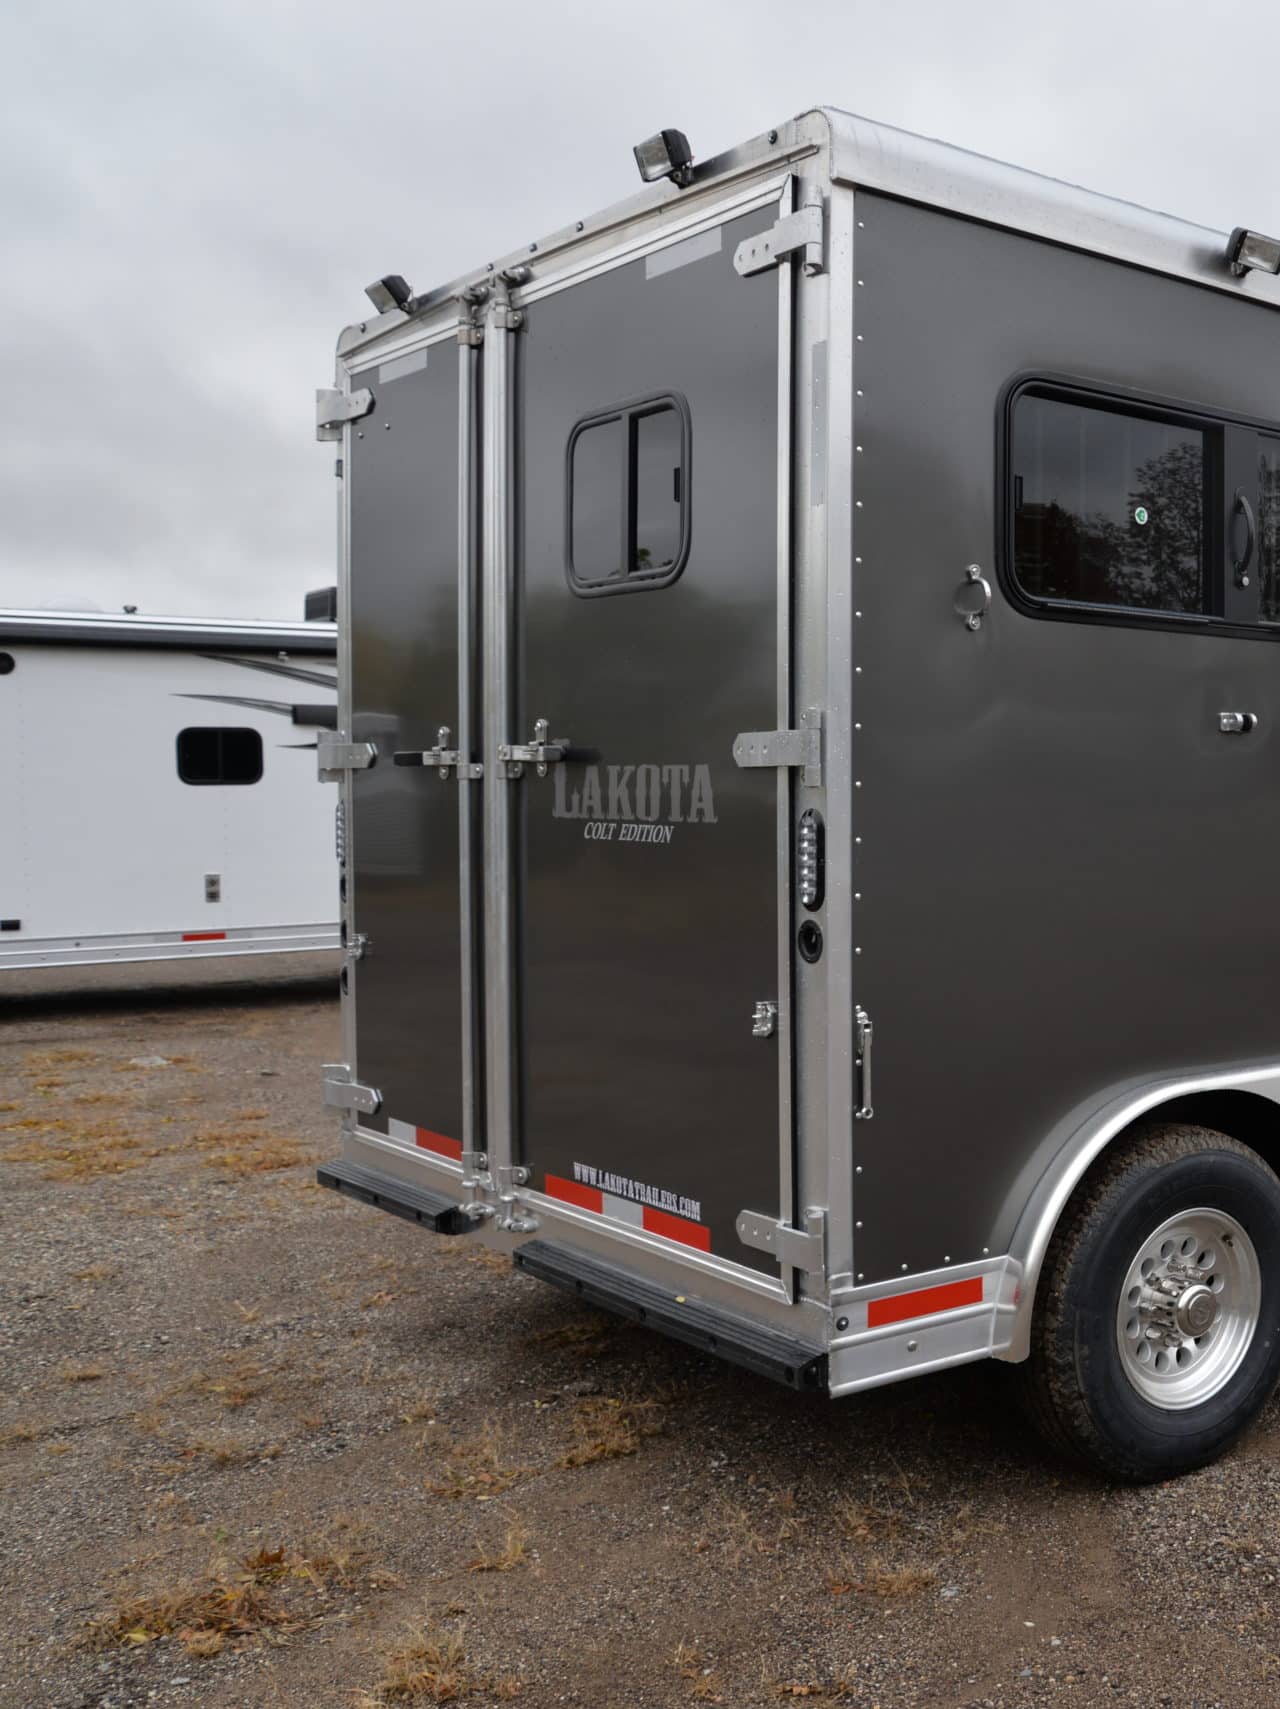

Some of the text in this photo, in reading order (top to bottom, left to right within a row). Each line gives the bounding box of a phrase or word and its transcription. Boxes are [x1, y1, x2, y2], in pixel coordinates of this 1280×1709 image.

[552, 738, 718, 823] LAKOTA
[584, 822, 674, 843] COLT EDITION
[573, 1161, 701, 1222] WWW.LAKOTATRAILERS.COM
